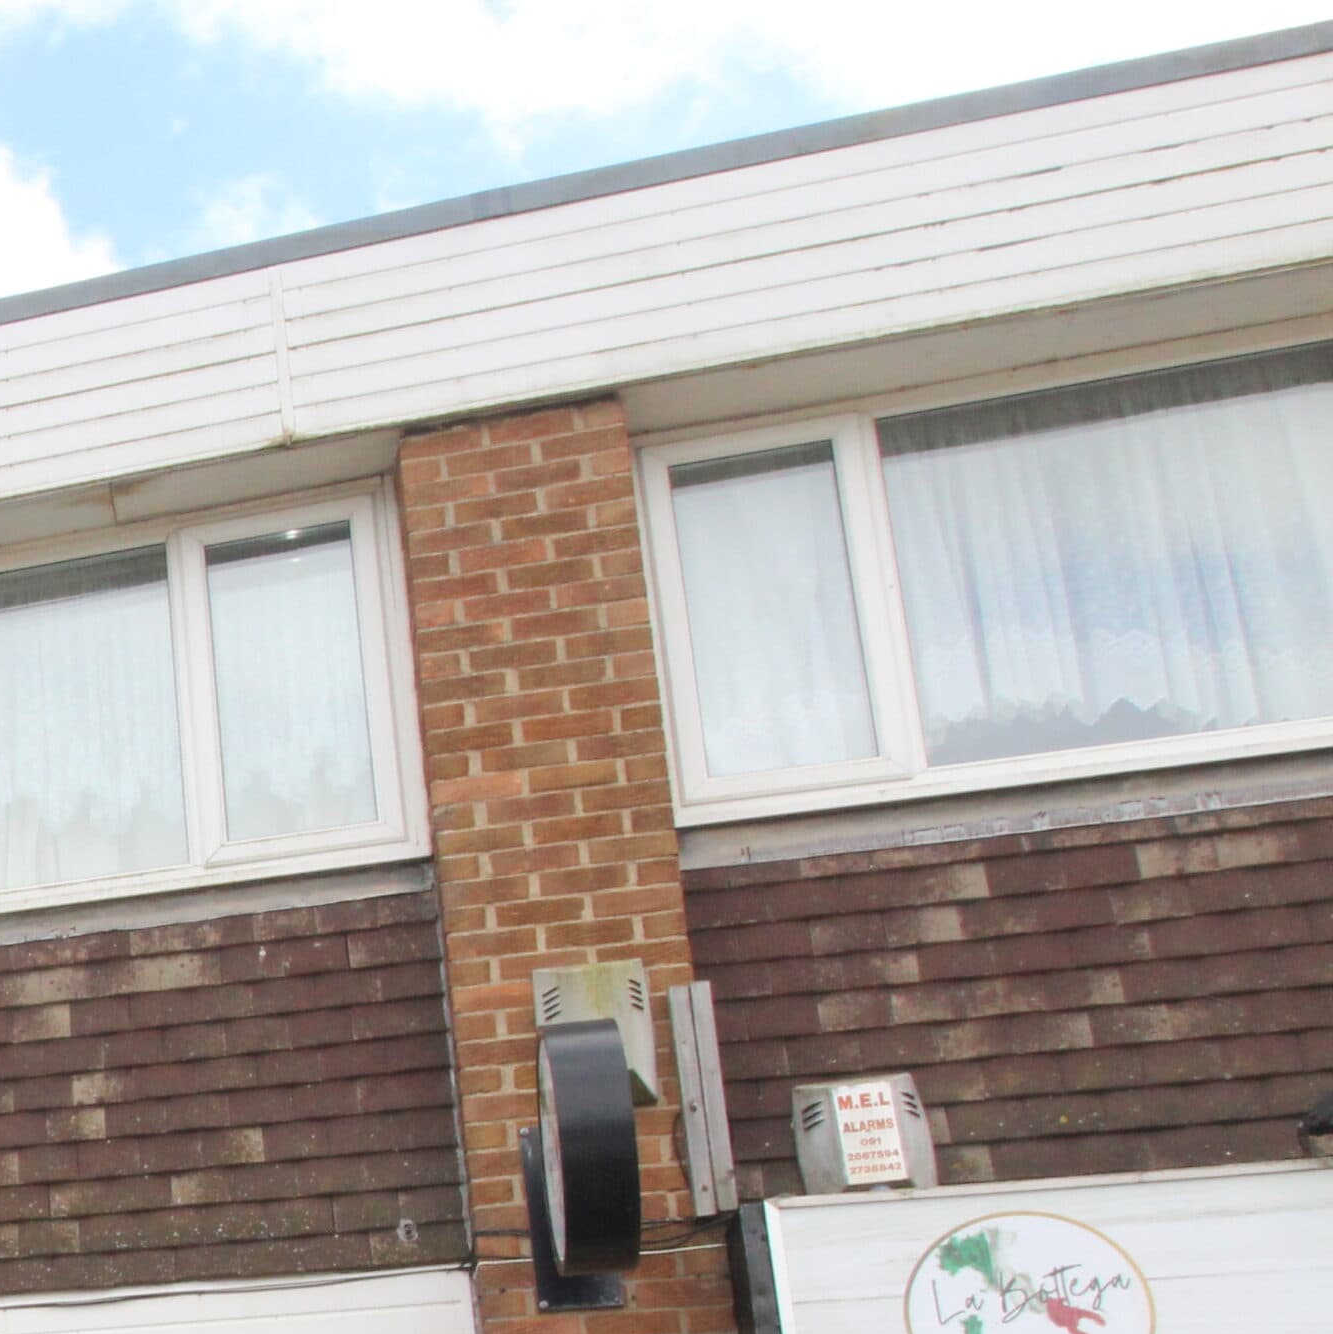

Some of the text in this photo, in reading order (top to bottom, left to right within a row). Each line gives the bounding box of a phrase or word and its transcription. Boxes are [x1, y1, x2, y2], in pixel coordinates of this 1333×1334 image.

[837, 1091, 890, 1111] M.E.L
[843, 1118, 894, 1133] ALARMS
[860, 1137, 881, 1146] 091
[932, 1264, 1131, 1326] La Bottega
